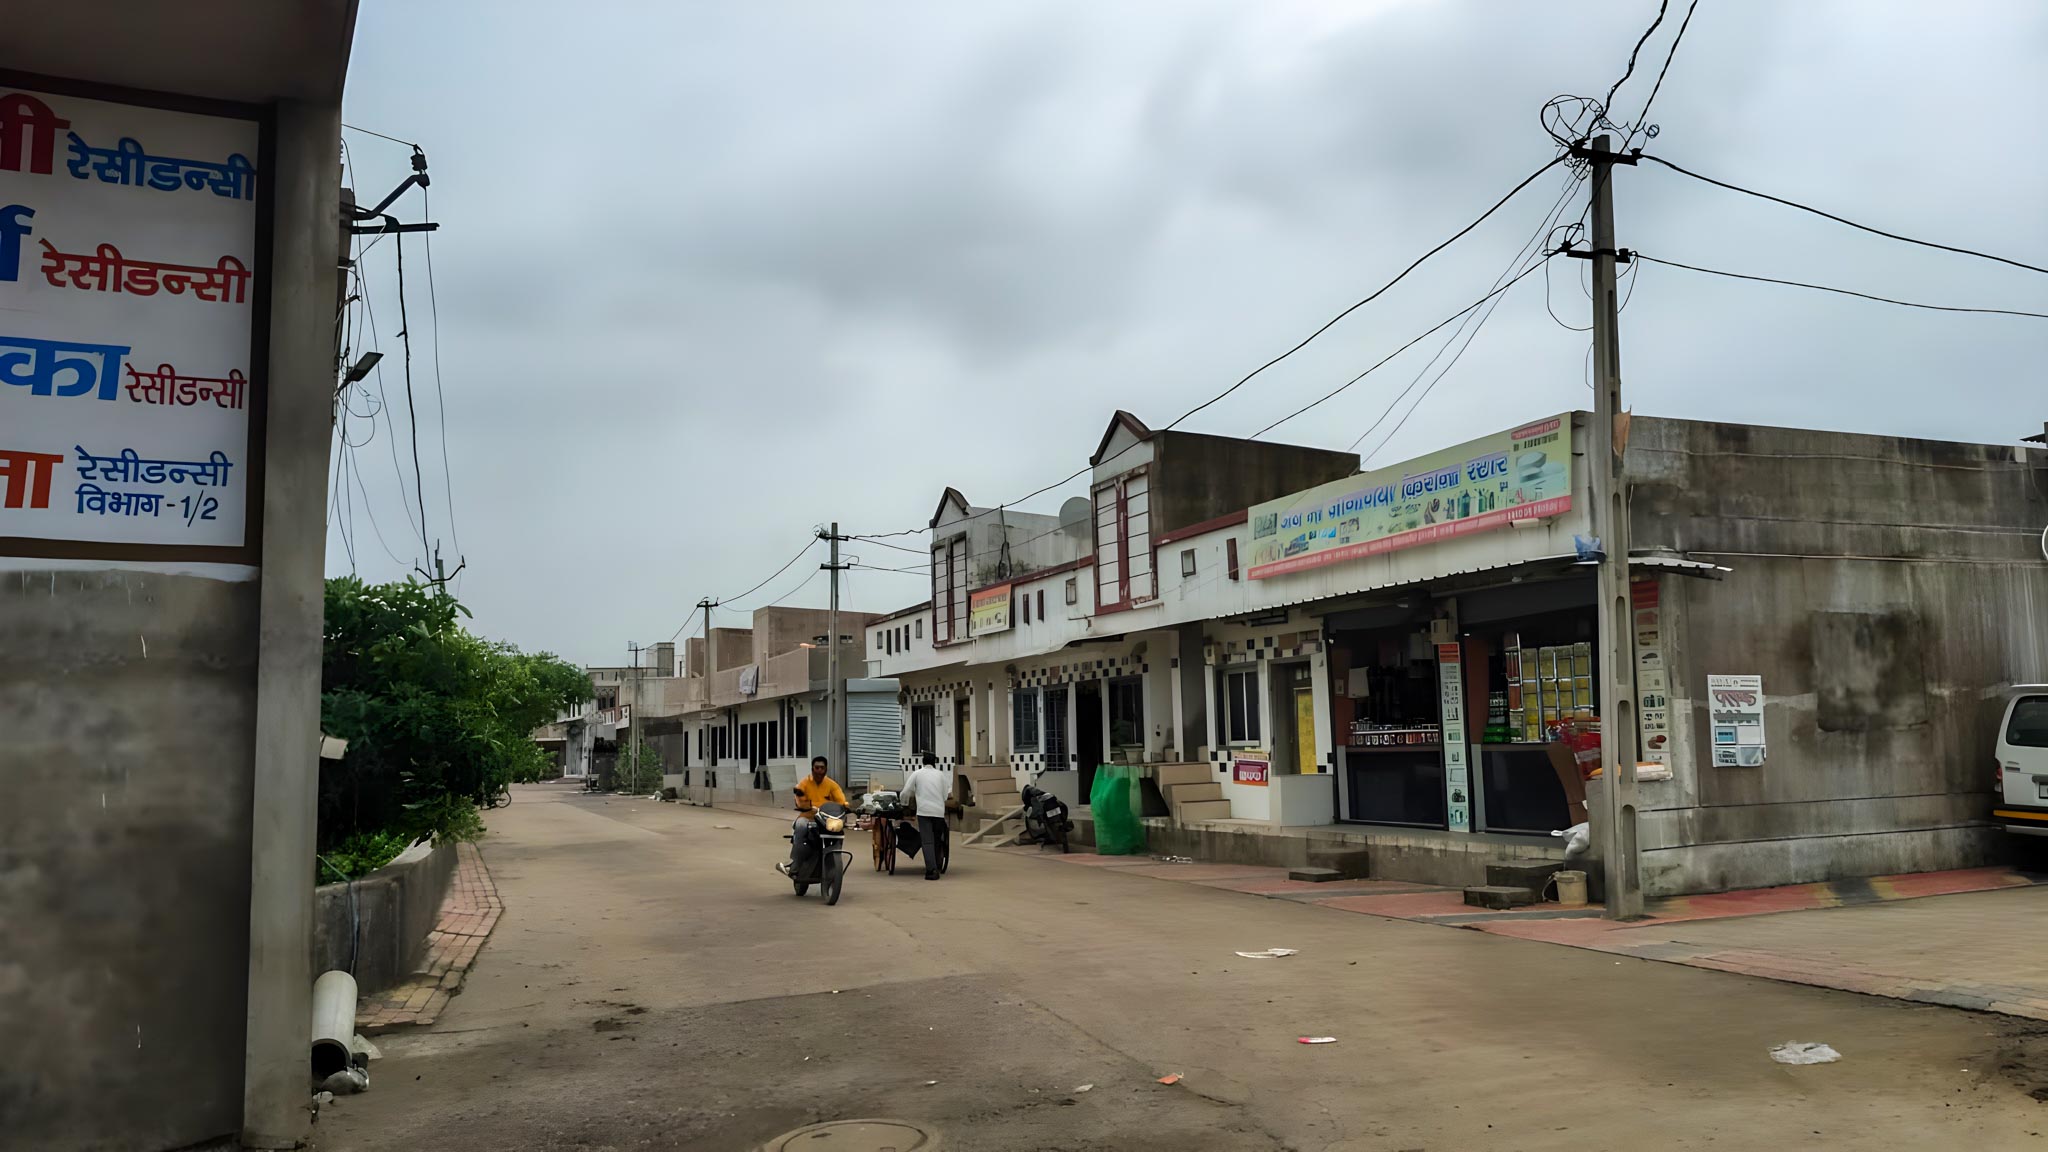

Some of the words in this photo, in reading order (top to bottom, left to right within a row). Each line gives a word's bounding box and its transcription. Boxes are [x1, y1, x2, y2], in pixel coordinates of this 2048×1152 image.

[67, 131, 257, 200] रेसीडन्सी
[38, 238, 252, 303] रेसीडन्सी
[124, 362, 247, 409] रेसीडन्सी
[74, 445, 233, 487] रेसीडन्सी
